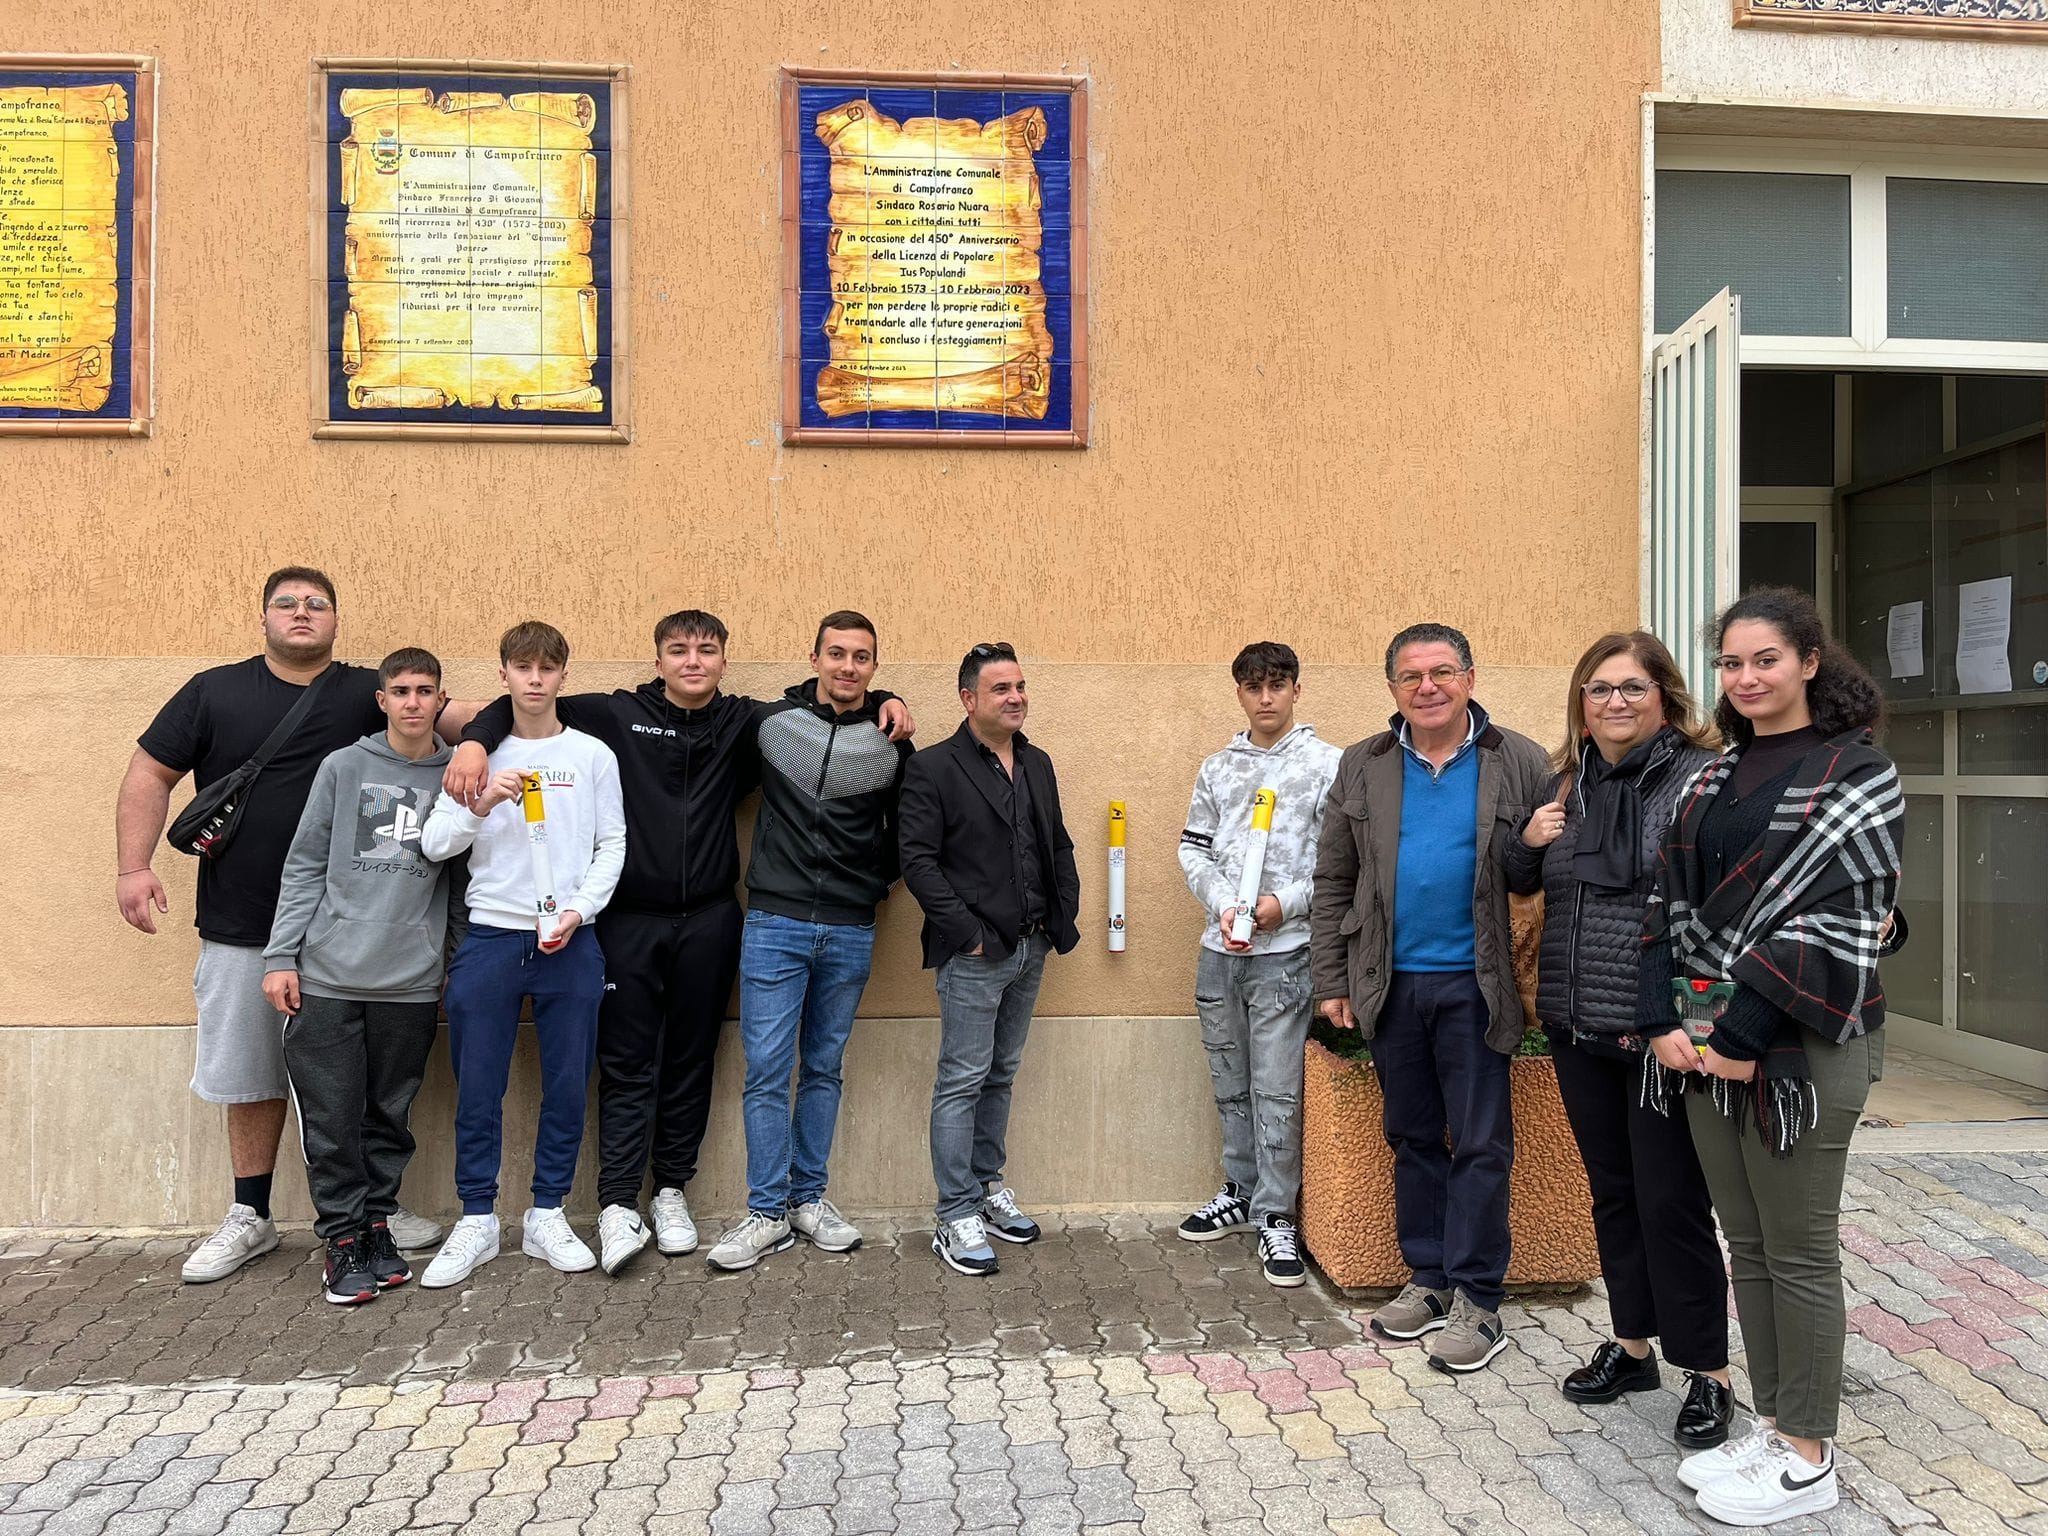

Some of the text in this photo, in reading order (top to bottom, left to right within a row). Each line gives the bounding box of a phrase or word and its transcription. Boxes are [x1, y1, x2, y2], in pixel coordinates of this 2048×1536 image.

[0, 97, 60, 113] ampofranco
[9, 155, 54, 163] incastonata
[410, 148, 562, 162] Comune di Campofranco
[23, 166, 57, 174] smeraldo
[864, 164, 1001, 179] L'Amministrazione Comunale
[12, 176, 26, 185] che
[31, 176, 63, 185] sfiorisce
[403, 181, 486, 191] L'Amministrazione
[892, 183, 973, 196] di Campofranco
[9, 197, 35, 206] strade
[399, 193, 432, 202] Sindaco
[439, 194, 481, 203] Francesco
[505, 195, 543, 204] Giovanni
[424, 205, 459, 214] cittadini
[479, 207, 537, 217] Campofranco
[876, 199, 989, 212] Sindaco Rosario Nuara
[379, 218, 400, 226] nella
[405, 218, 451, 227] ricorrenza
[457, 219, 469, 227] del
[502, 219, 567, 230] (1573-2003)
[885, 218, 902, 226] con
[911, 216, 954, 226] cittadini
[958, 217, 981, 227] tutti
[2, 232, 10, 240] di
[366, 230, 421, 239] anniversario
[427, 231, 449, 240] della
[453, 231, 502, 241] fondazione
[507, 233, 520, 241] del
[847, 232, 1020, 245] in occasione del 450° Anniversario
[3, 242, 26, 251] umile
[37, 243, 68, 254] regale
[16, 252, 36, 262] nelle
[42, 254, 74, 264] chiese,
[371, 254, 404, 263] Memori
[421, 255, 441, 265] grati
[447, 257, 461, 265] per
[467, 256, 473, 264] il
[479, 257, 527, 267] prestigioso
[534, 258, 571, 267] percorso
[872, 249, 995, 265] della Licenza di Popolare
[0, 265, 22, 276] ampi,
[25, 265, 37, 273] nel
[41, 264, 55, 273] tuo
[385, 266, 415, 275] storico
[421, 267, 466, 276] economico
[472, 268, 502, 277] sociale
[899, 266, 966, 280] Ius Populandi
[6, 280, 21, 288] tua
[405, 279, 450, 290] orgogliosi
[482, 280, 500, 289] loro
[837, 282, 850, 293] 10
[853, 282, 897, 293] Febbraio
[901, 284, 927, 294] 1573
[940, 285, 954, 294] 10
[957, 284, 1001, 295] Febbraio
[1004, 285, 1030, 295] 2023
[26, 290, 39, 299] nel
[44, 290, 58, 298] tuo
[420, 291, 523, 302] certi del loro impegno
[14, 300, 29, 309] tua
[402, 302, 440, 311] fiduciosi
[446, 304, 460, 312] per
[466, 303, 472, 311] il
[479, 303, 496, 312] loro
[846, 300, 1020, 314] per non perdere le proprie radici e
[38, 311, 74, 321] stanchi
[844, 316, 1022, 331] tramandarle alle future generazioni
[18, 333, 31, 342] tuo
[37, 333, 72, 347] grembo
[860, 333, 873, 344] ha
[879, 334, 921, 345] concluso
[931, 333, 1007, 348] festeggiamenti
[21, 350, 51, 359] Madre
[352, 860, 429, 879] プレイステーション
